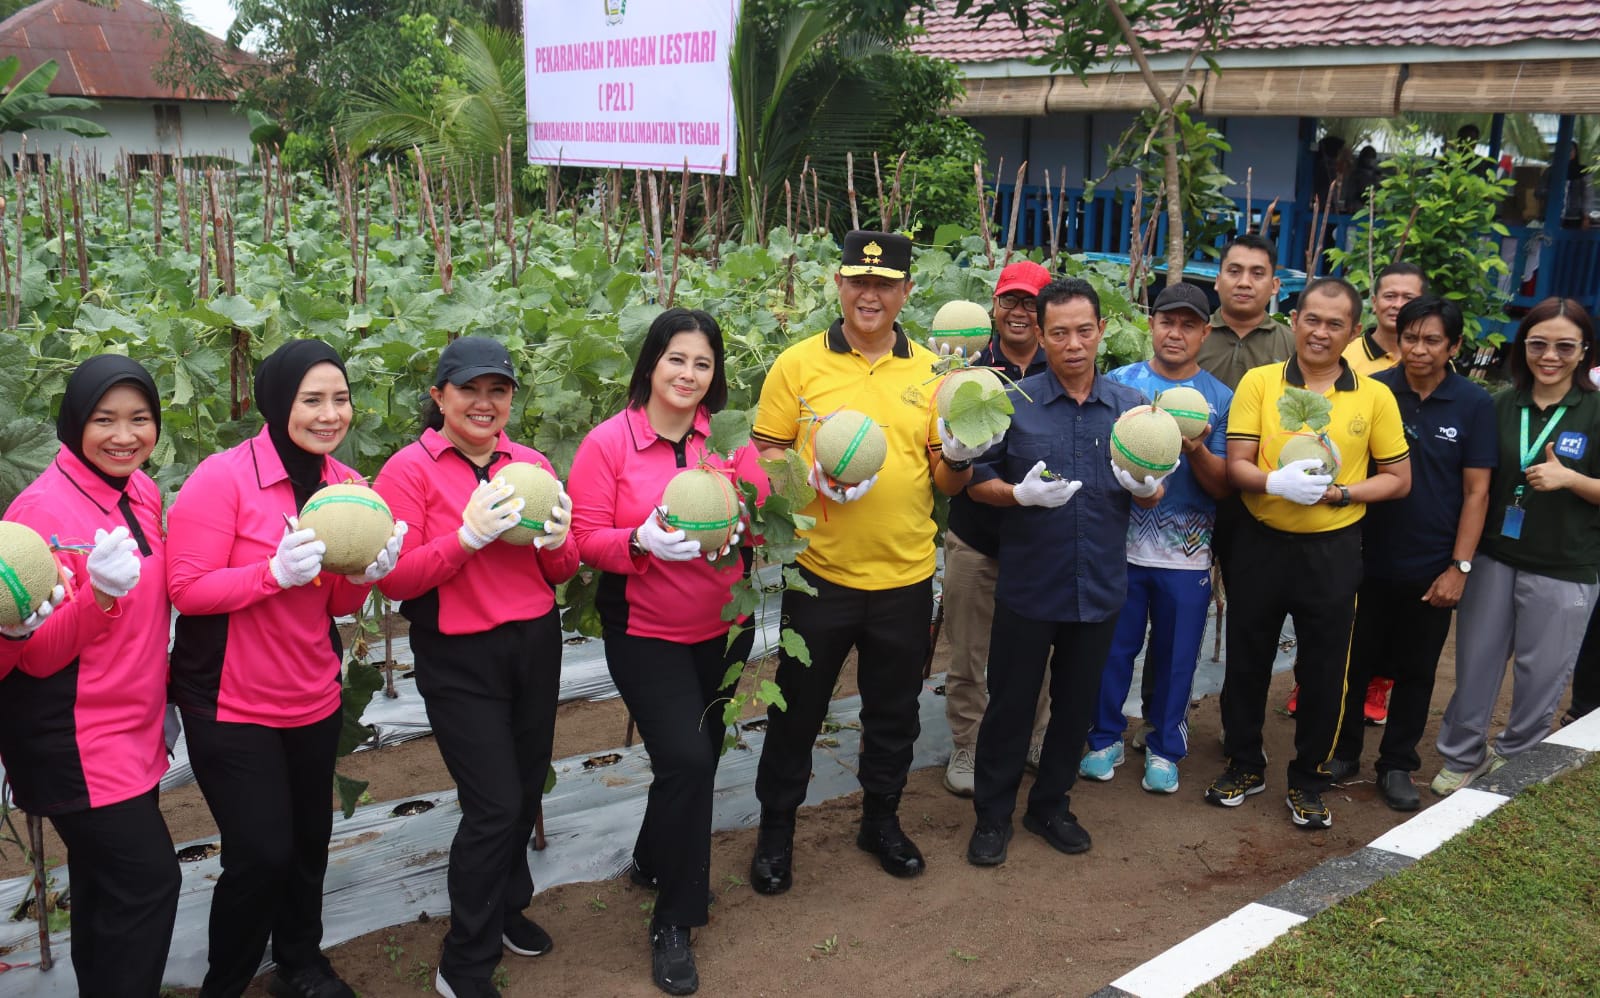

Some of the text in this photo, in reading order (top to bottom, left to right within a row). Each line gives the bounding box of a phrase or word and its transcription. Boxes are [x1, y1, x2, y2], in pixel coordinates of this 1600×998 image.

[535, 30, 717, 73] PEKARANGAN PANGAN LESTARI
[534, 121, 720, 146] BHAYANGKARI DAERAH KALIMANTAN TENGAH
